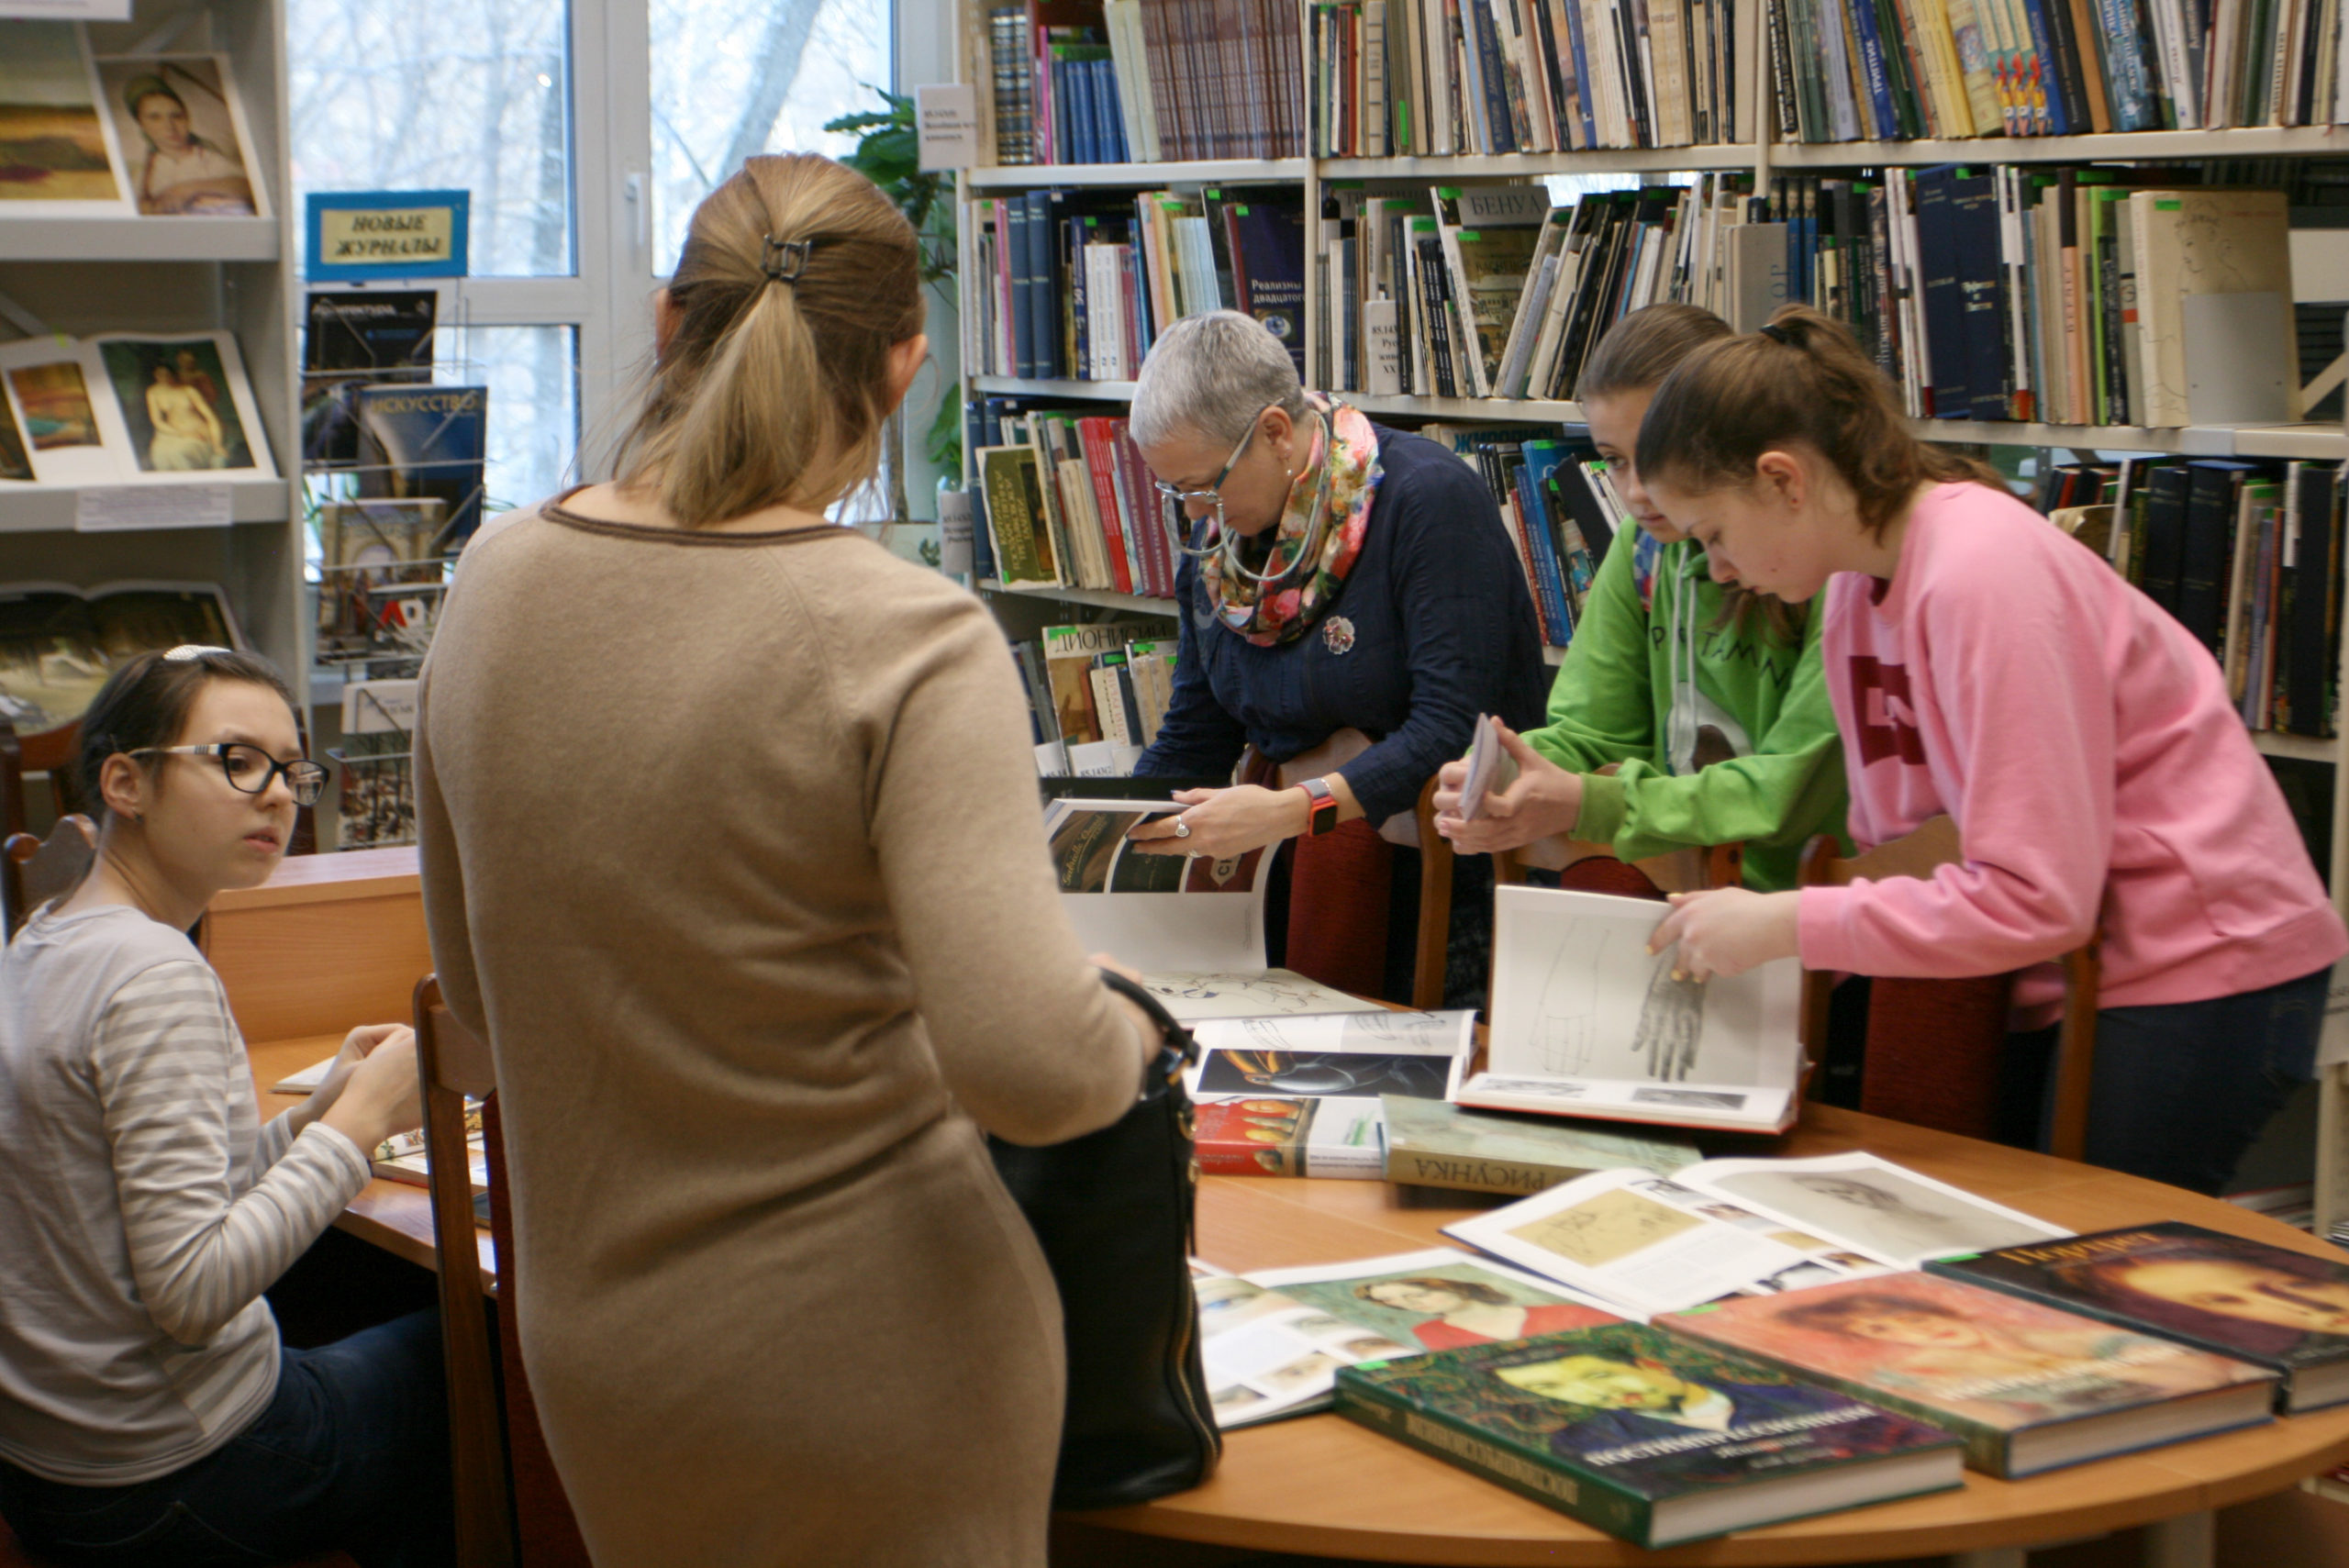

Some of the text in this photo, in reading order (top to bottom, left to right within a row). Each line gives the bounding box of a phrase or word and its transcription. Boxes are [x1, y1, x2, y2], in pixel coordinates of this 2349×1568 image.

[1865, 39, 1884, 95] ТРИПТИХ
[351, 214, 427, 231] НОВЫЕ
[335, 237, 440, 257] ЖУРНАЛЫ
[1251, 279, 1302, 291] Реализмы
[1414, 1157, 1546, 1191] РИСУНКА
